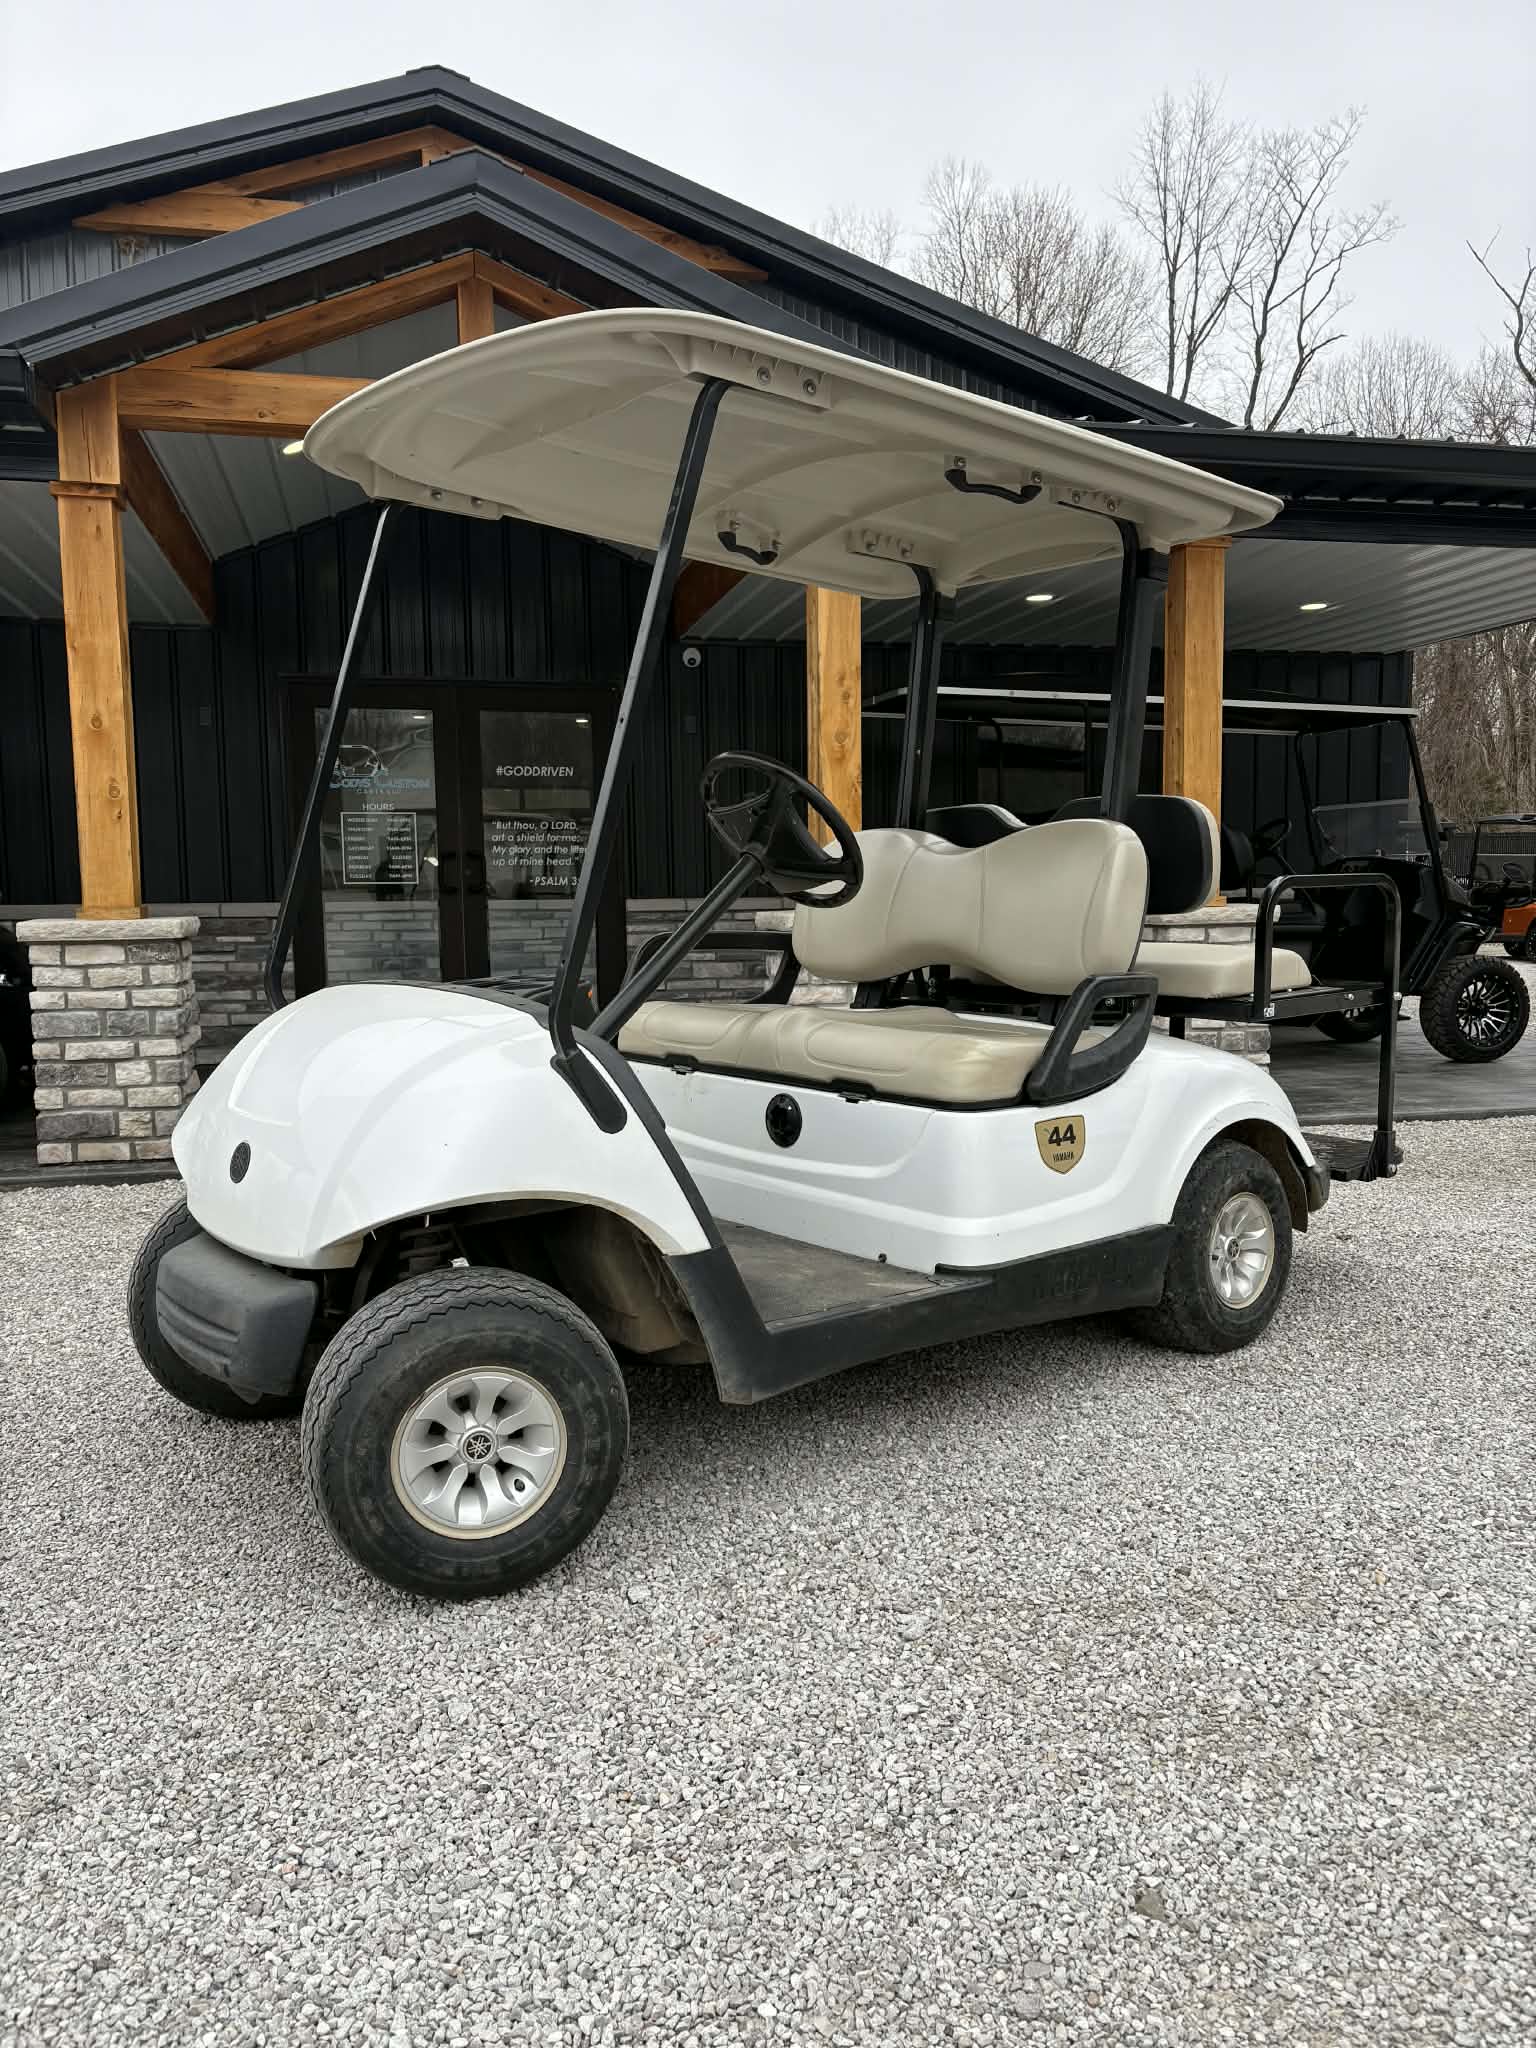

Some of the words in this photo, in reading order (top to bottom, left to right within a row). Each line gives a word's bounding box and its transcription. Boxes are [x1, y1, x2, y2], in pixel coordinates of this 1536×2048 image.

[496, 765, 575, 777] #GODDRIVEN
[361, 802, 395, 811] HOURS
[513, 820, 536, 831] thou,
[540, 821, 548, 830] O
[491, 832, 505, 842] art
[507, 834, 514, 842] a
[516, 832, 545, 842] shield
[492, 845, 506, 856] My
[534, 845, 552, 854] and
[553, 845, 568, 854] the
[492, 858, 505, 868] up
[508, 856, 517, 866] of
[519, 856, 544, 865] mine
[1048, 1124, 1076, 1146] 44
